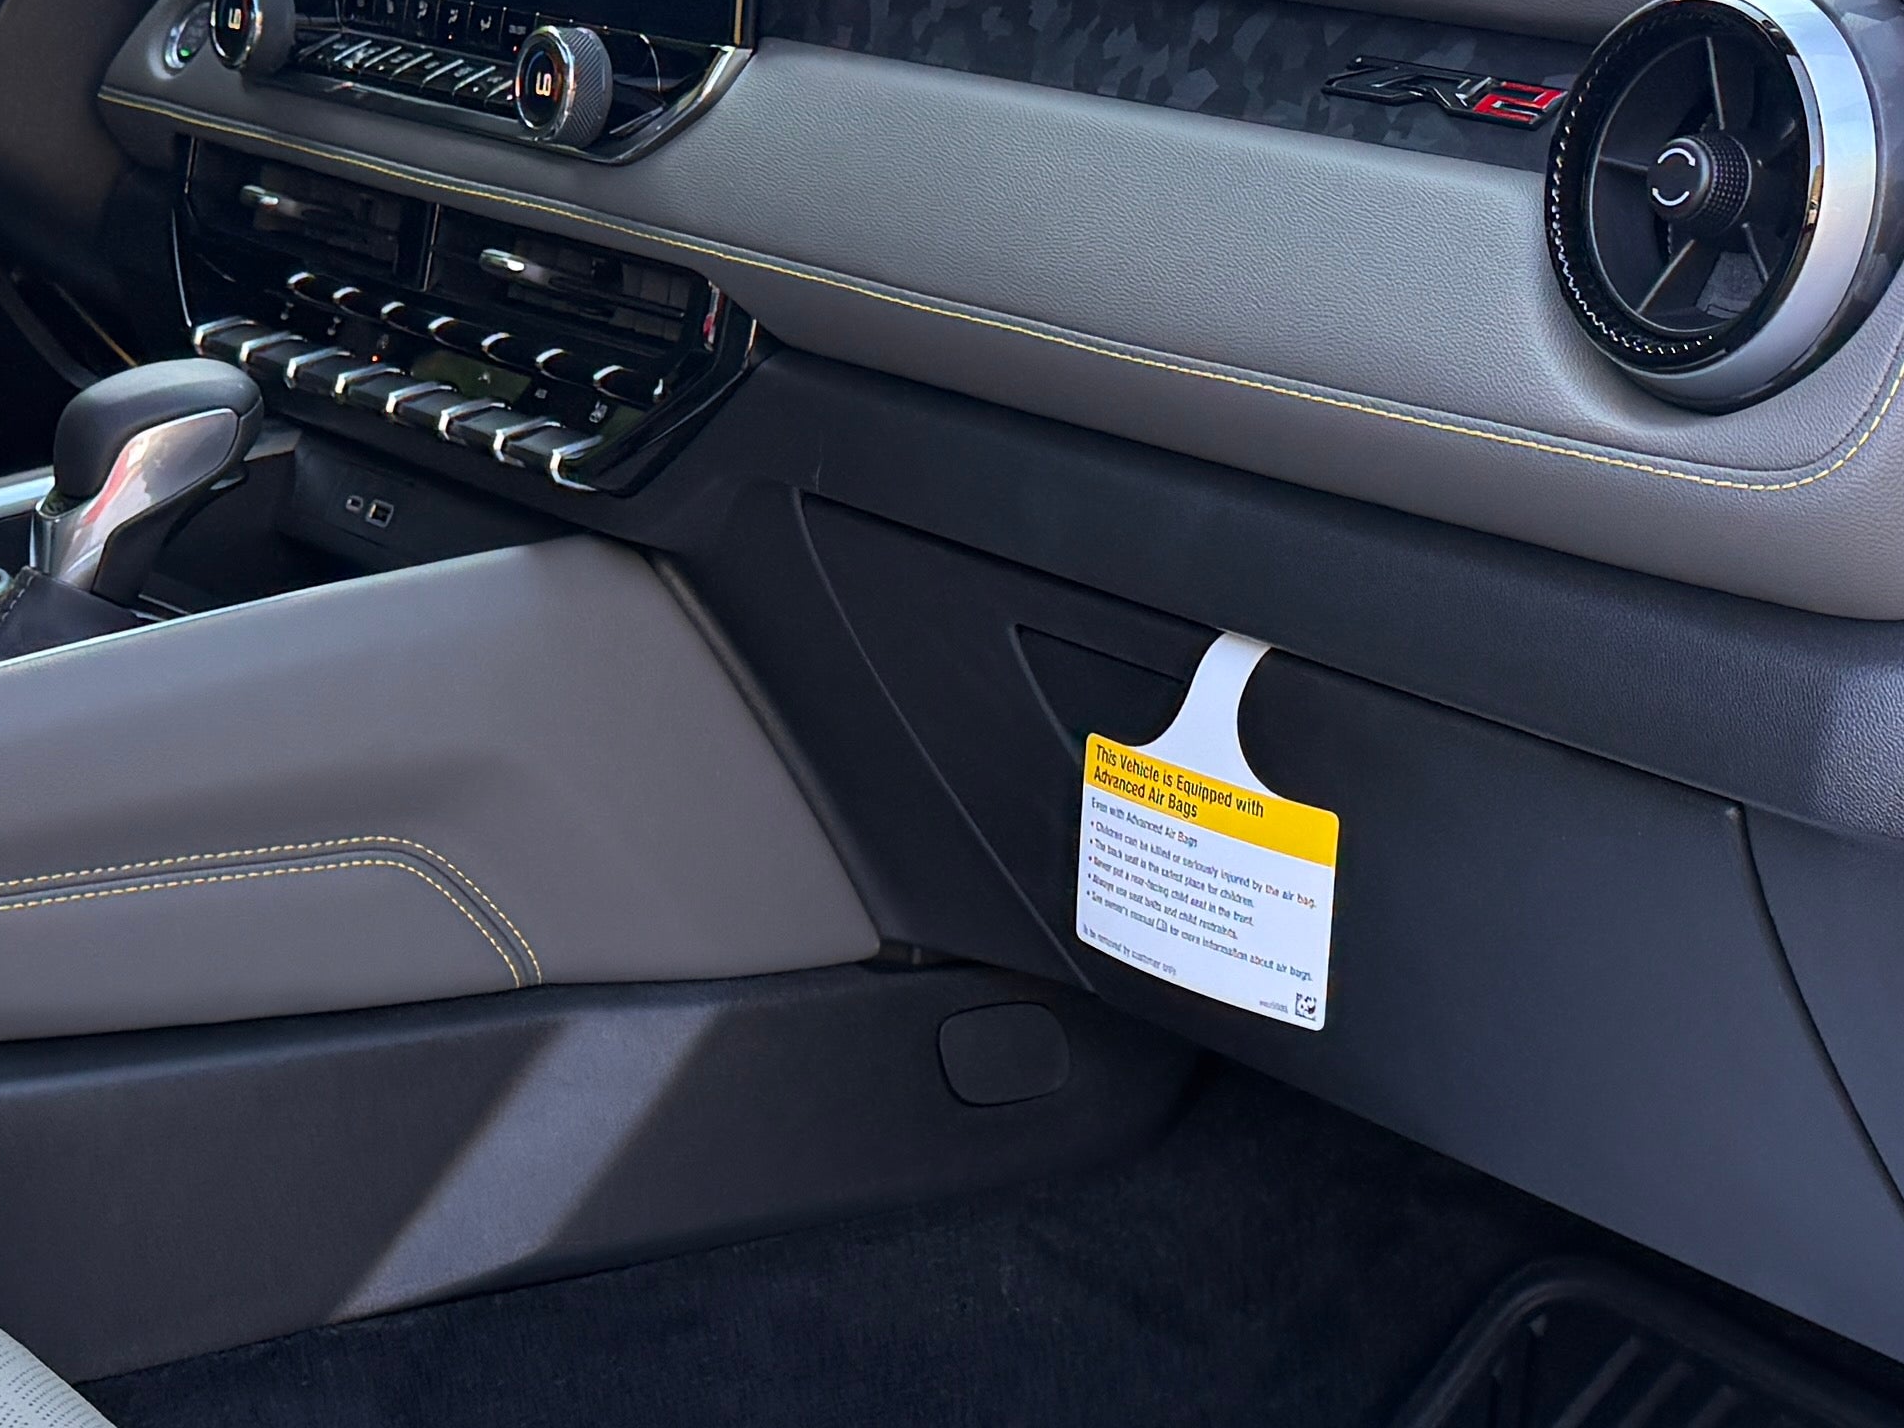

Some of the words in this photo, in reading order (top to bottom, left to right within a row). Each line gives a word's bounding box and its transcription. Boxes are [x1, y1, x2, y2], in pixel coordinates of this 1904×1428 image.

[1321, 55, 1569, 132] ZR2
[1093, 765, 1145, 799] Advanced
[1148, 786, 1165, 806] Air
[1168, 793, 1198, 819] Bags
[1096, 744, 1117, 767] This
[1120, 754, 1159, 783] Vehicle
[1163, 769, 1173, 787] is
[1176, 775, 1232, 808] Equipped
[1236, 798, 1264, 818] with
[1126, 812, 1163, 836] Advanced
[1165, 827, 1176, 839] Air
[1177, 831, 1198, 848] Bags
[1182, 857, 1218, 878] seriously
[1252, 878, 1263, 893] by
[1265, 884, 1280, 897] the
[1282, 890, 1295, 901] air
